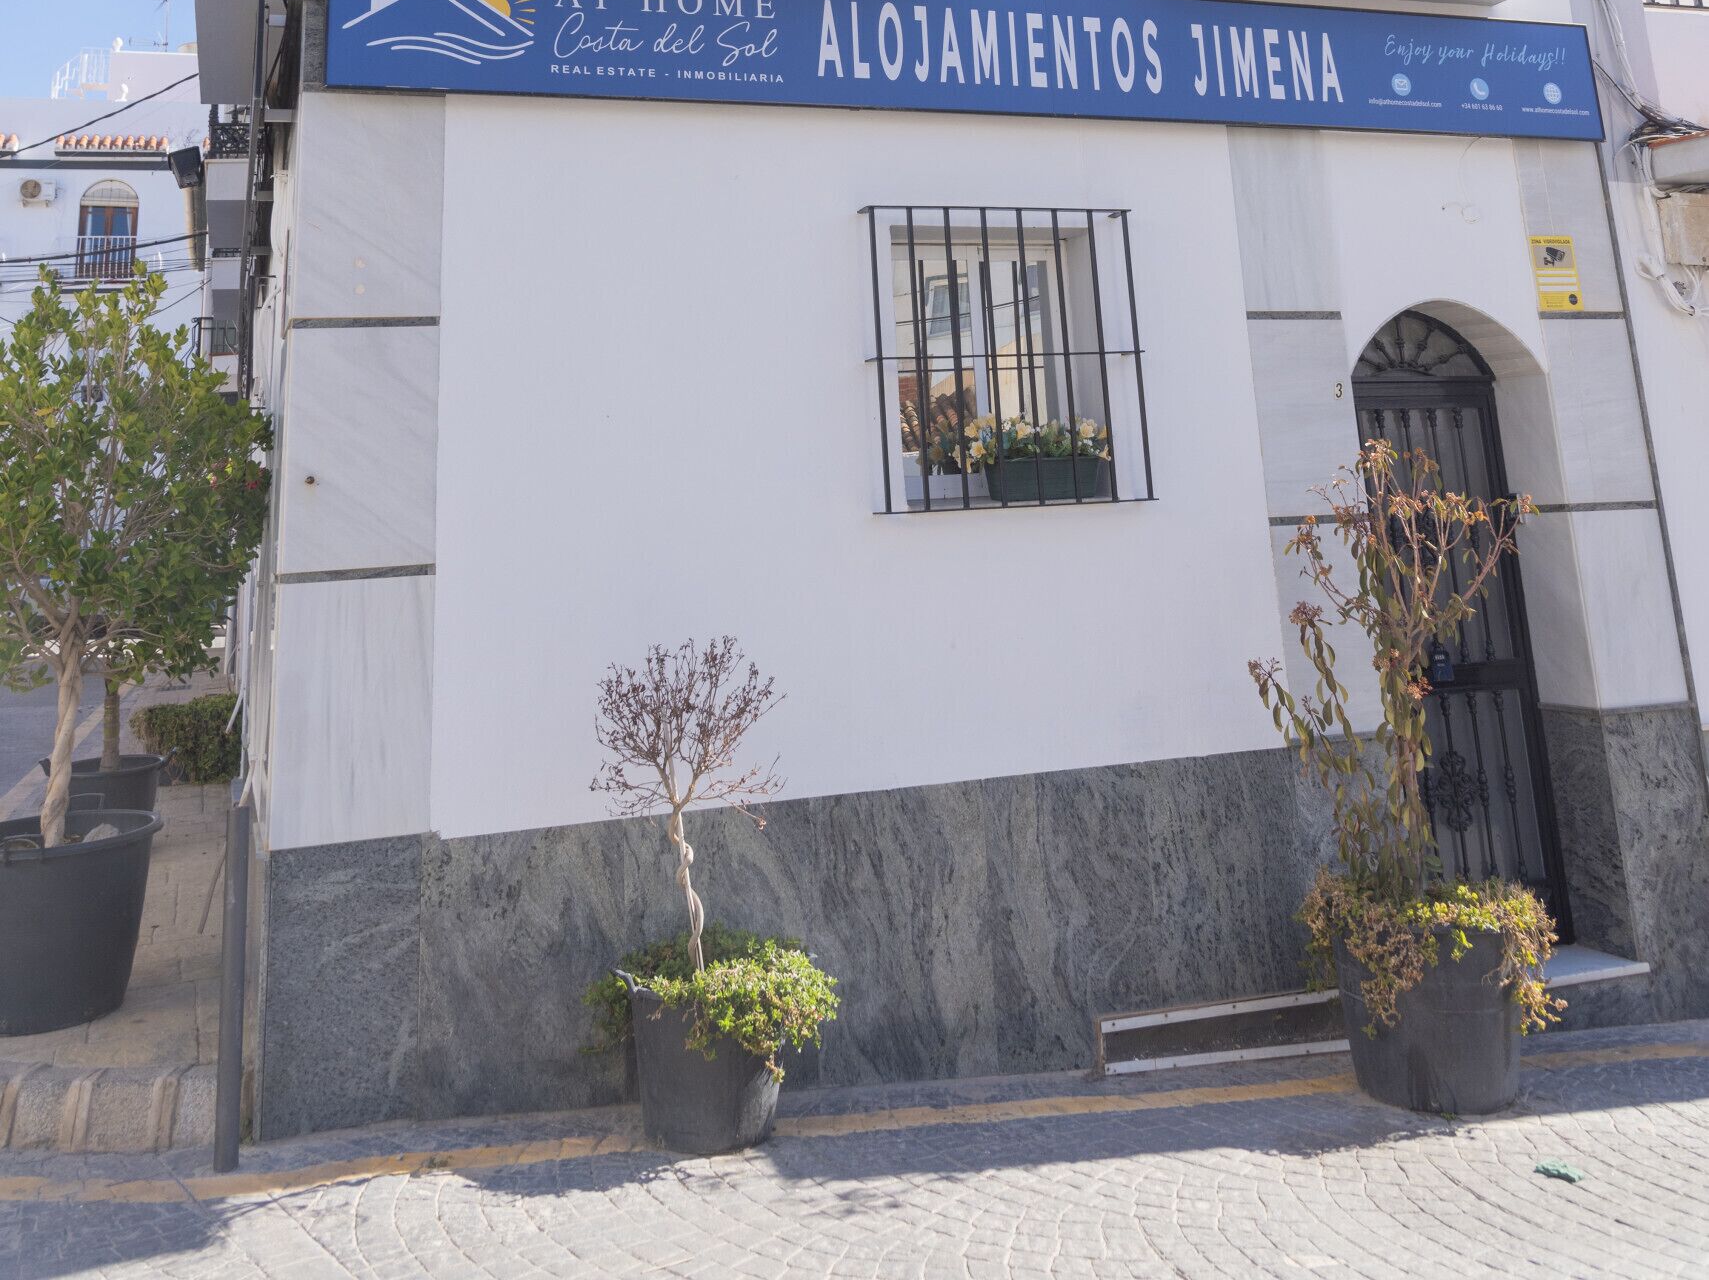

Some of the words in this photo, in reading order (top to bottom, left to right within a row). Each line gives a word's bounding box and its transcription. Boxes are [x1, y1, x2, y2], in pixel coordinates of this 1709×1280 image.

[553, 11, 644, 59] Costa
[653, 22, 705, 55] del
[716, 21, 778, 67] Sol
[817, 0, 1163, 94] ALOJAMIENTOS
[1191, 23, 1344, 103] JIMENA
[1384, 34, 1433, 66] Enjoy
[1438, 46, 1474, 65] your
[1481, 42, 1567, 71] Holidays!!
[550, 64, 591, 75] REAL
[597, 66, 656, 78] ESTATE
[677, 69, 784, 83] INMOBILIARIA
[1335, 382, 1343, 399] 3
